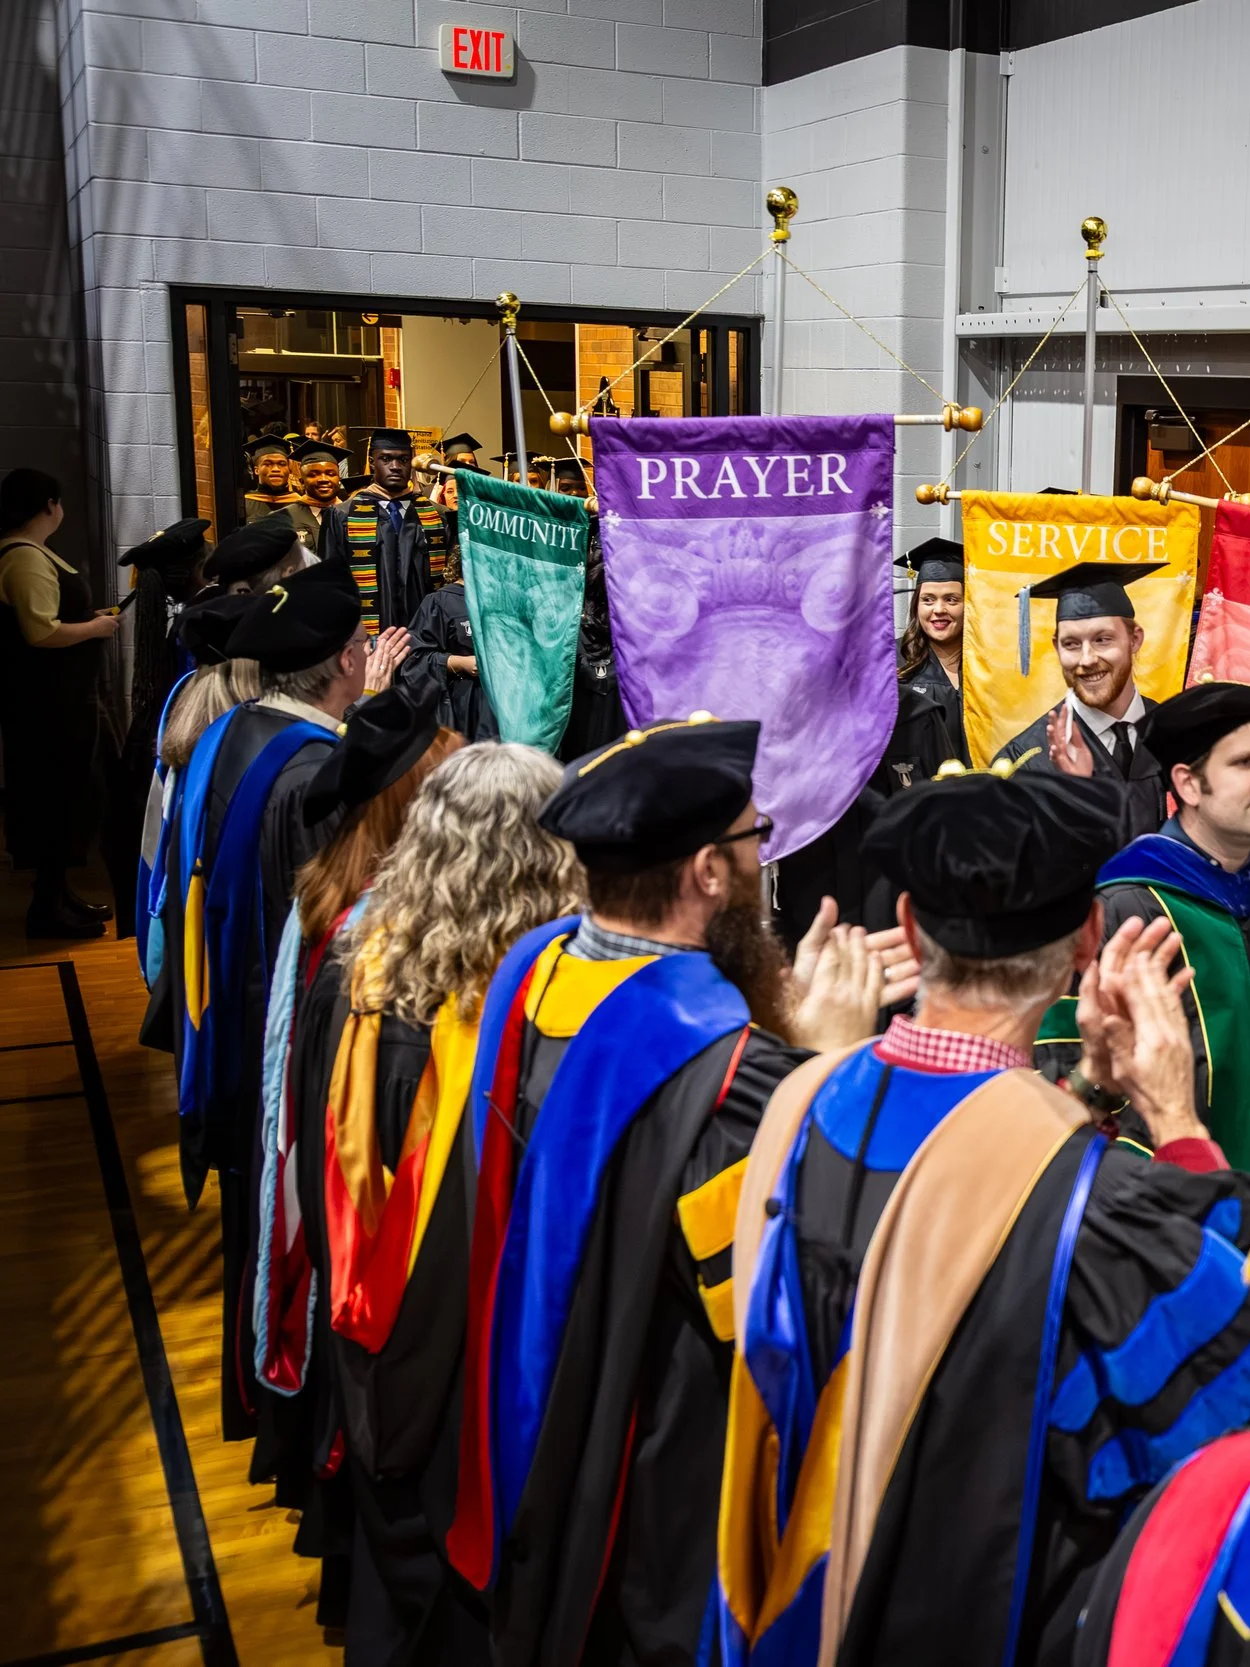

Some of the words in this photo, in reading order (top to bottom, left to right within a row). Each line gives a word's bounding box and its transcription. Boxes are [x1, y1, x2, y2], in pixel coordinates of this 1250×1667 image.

[453, 27, 505, 72] EXIT
[636, 453, 853, 499] PRAYER
[465, 500, 581, 550] OMMUNITY
[987, 521, 1169, 561] SERVICE
